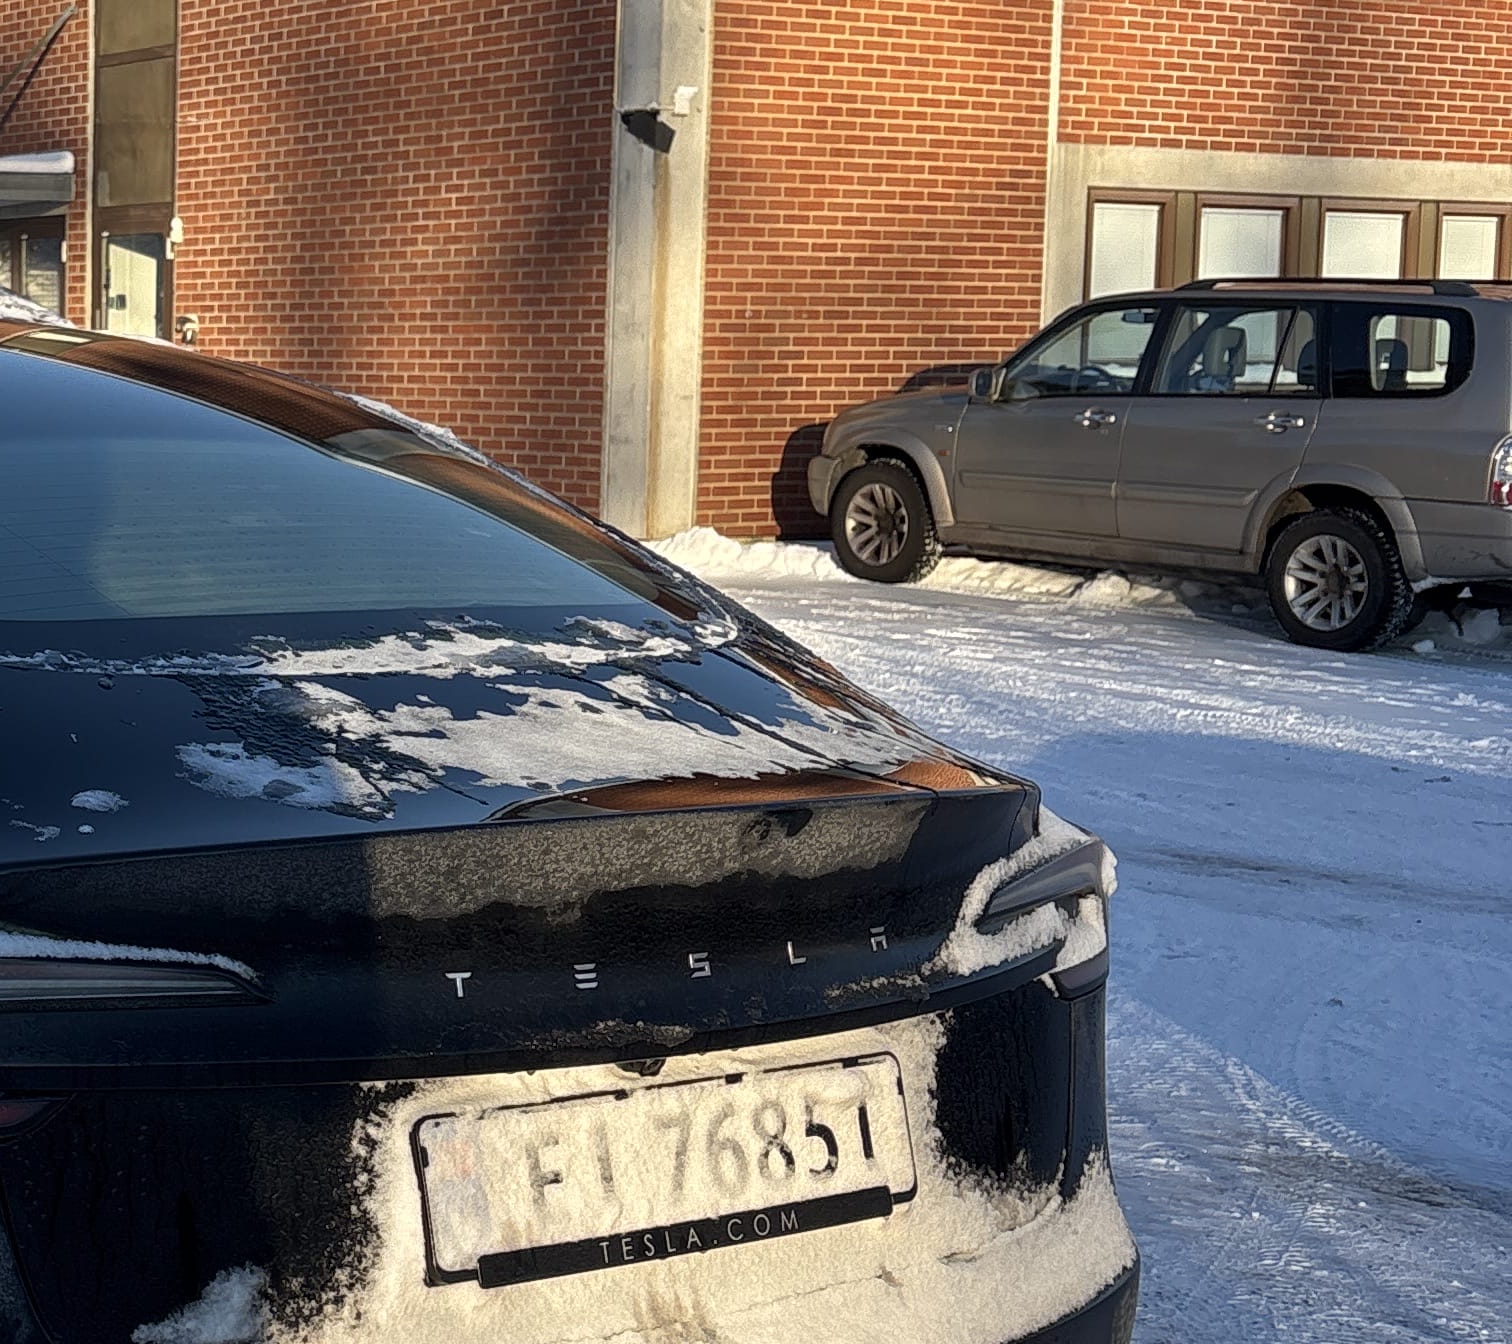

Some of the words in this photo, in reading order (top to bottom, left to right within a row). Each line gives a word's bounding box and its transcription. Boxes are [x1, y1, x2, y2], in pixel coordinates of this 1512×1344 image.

[445, 926, 888, 998] TESLA
[654, 1095, 876, 1202] 76851
[599, 1209, 800, 1264] TESLA.COM
